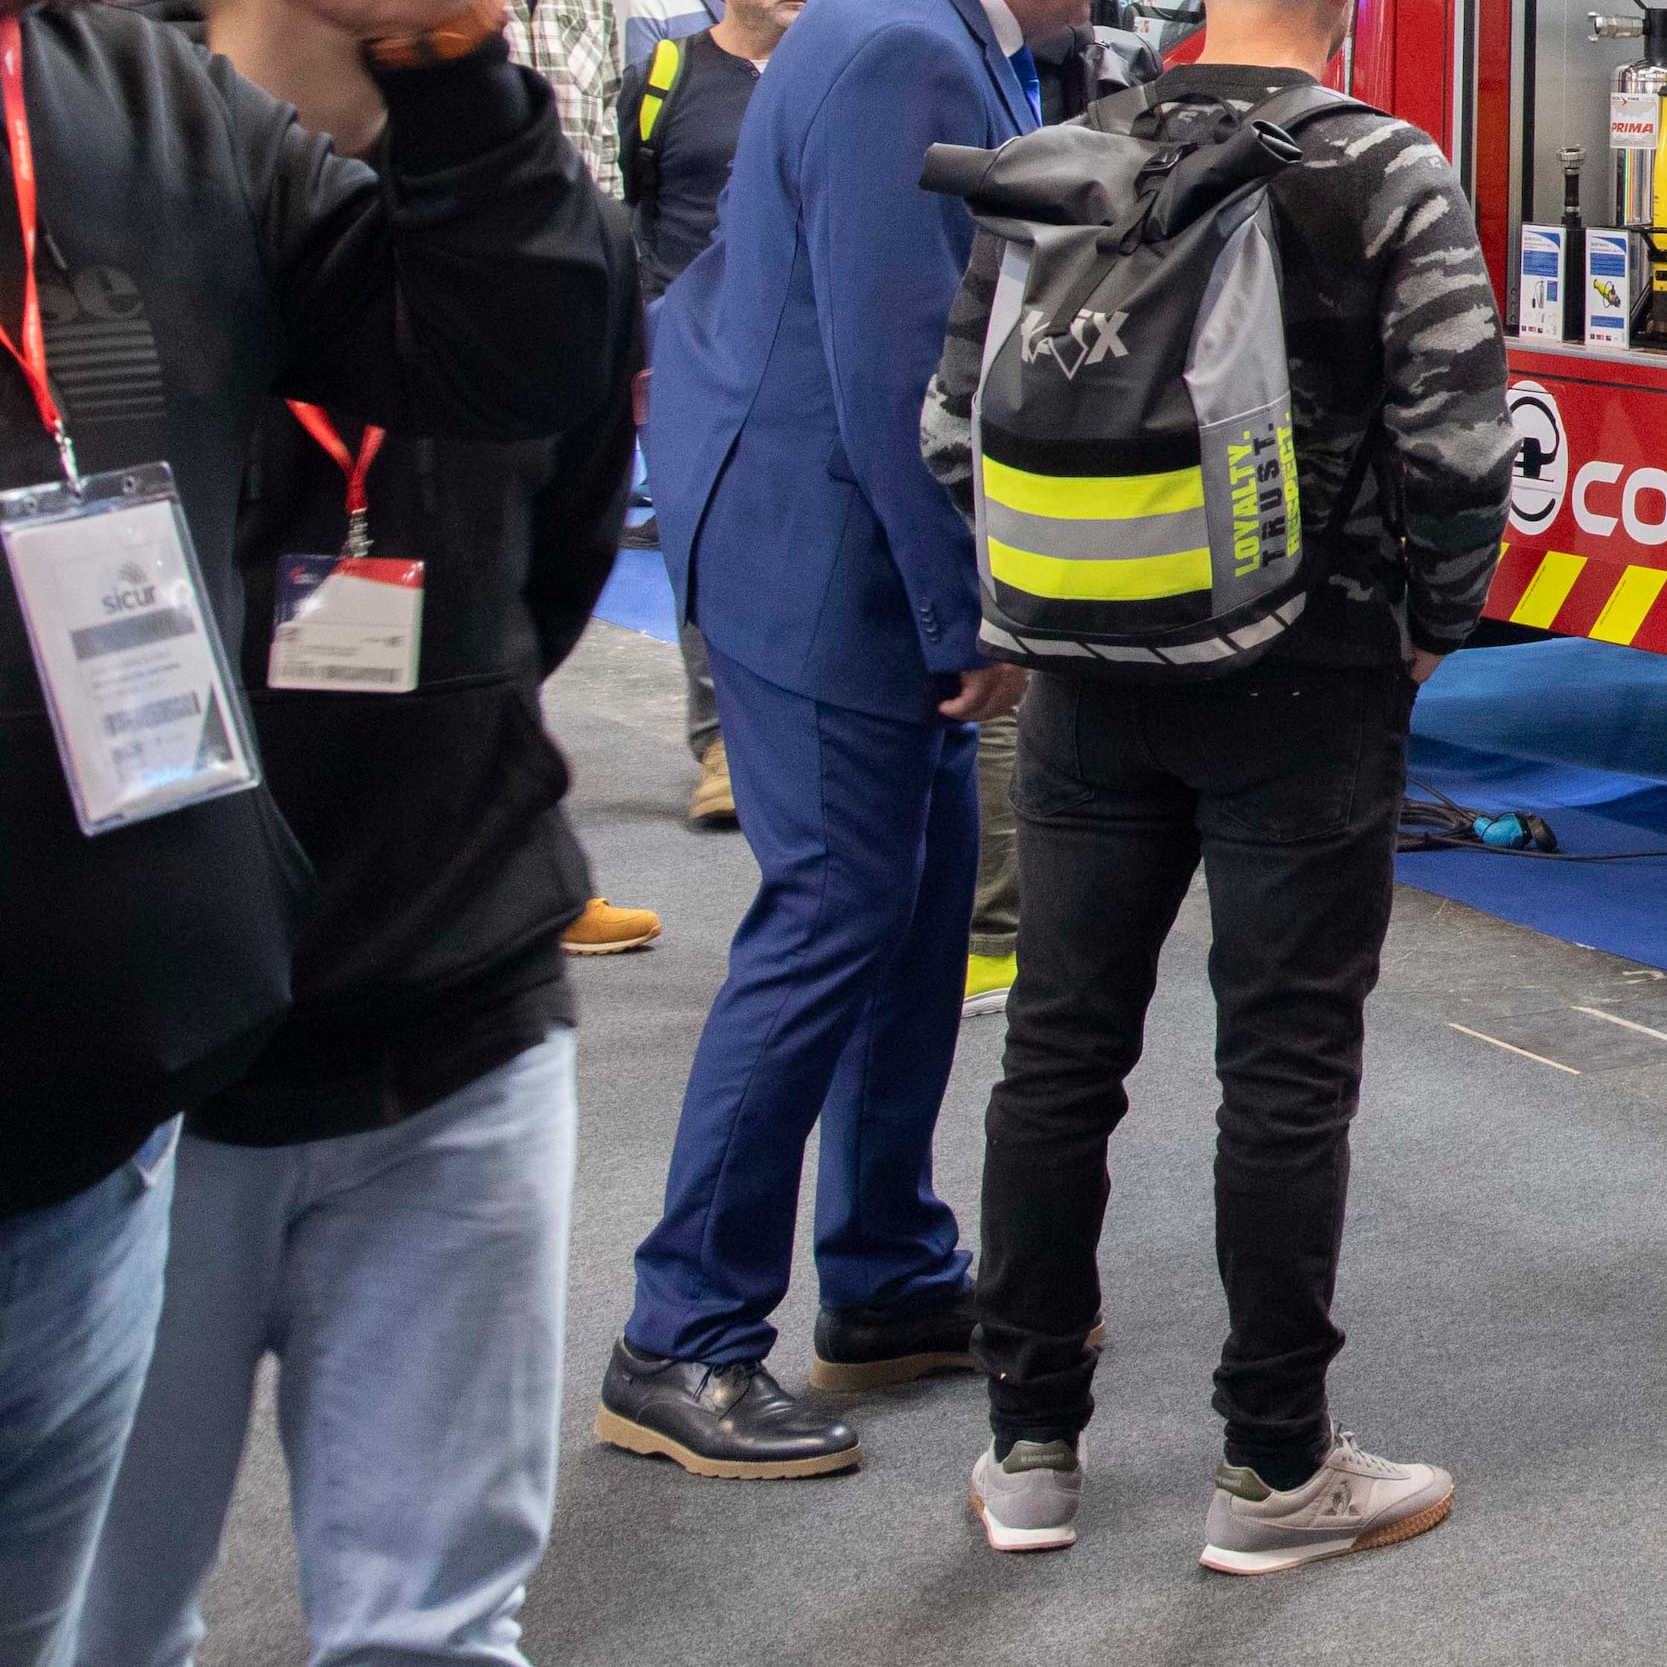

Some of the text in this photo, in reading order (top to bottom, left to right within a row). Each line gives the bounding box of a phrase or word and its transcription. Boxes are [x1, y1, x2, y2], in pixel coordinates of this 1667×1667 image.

[1611, 122, 1654, 134] PRIMA
[1227, 430, 1261, 577] LOYALTY.
[1253, 423, 1287, 568] TRUST.
